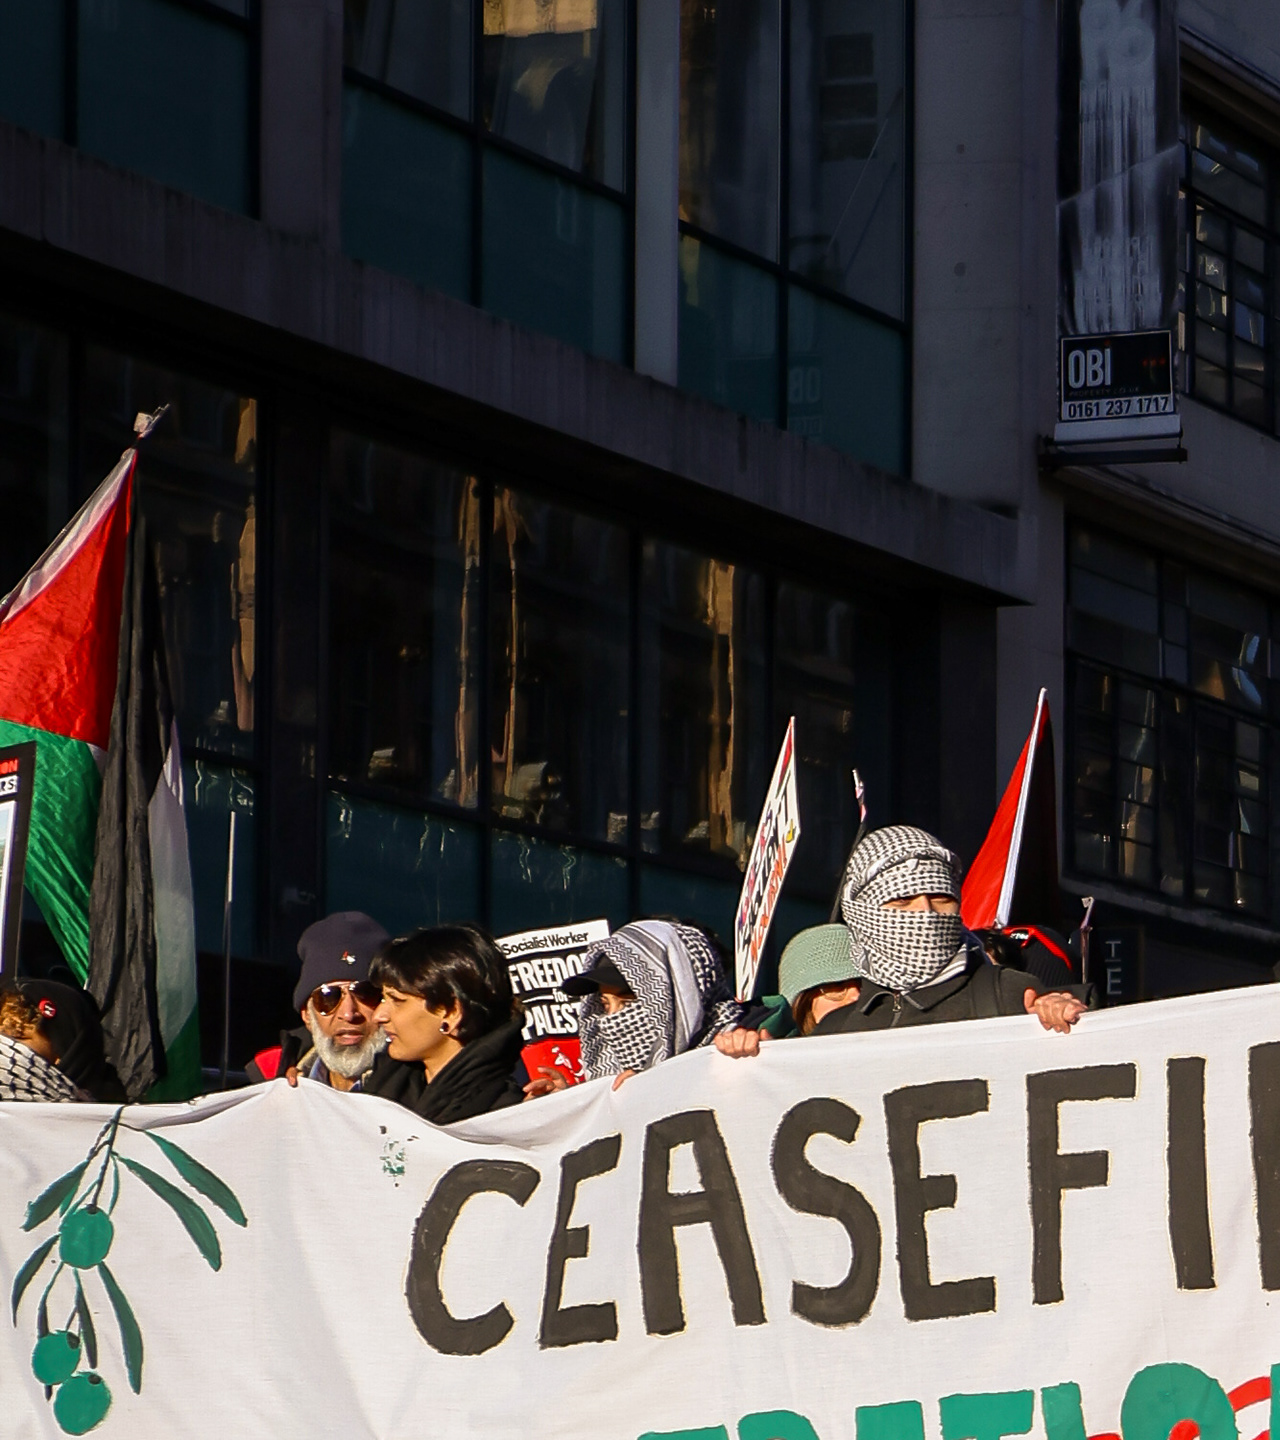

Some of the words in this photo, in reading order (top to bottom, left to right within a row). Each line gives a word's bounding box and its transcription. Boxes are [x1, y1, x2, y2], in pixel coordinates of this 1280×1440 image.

[1068, 402, 1100, 418] 0161
[1105, 400, 1132, 416] 237
[1137, 397, 1169, 413] 1717
[501, 936, 547, 955] Socialist
[547, 932, 589, 947] Worker
